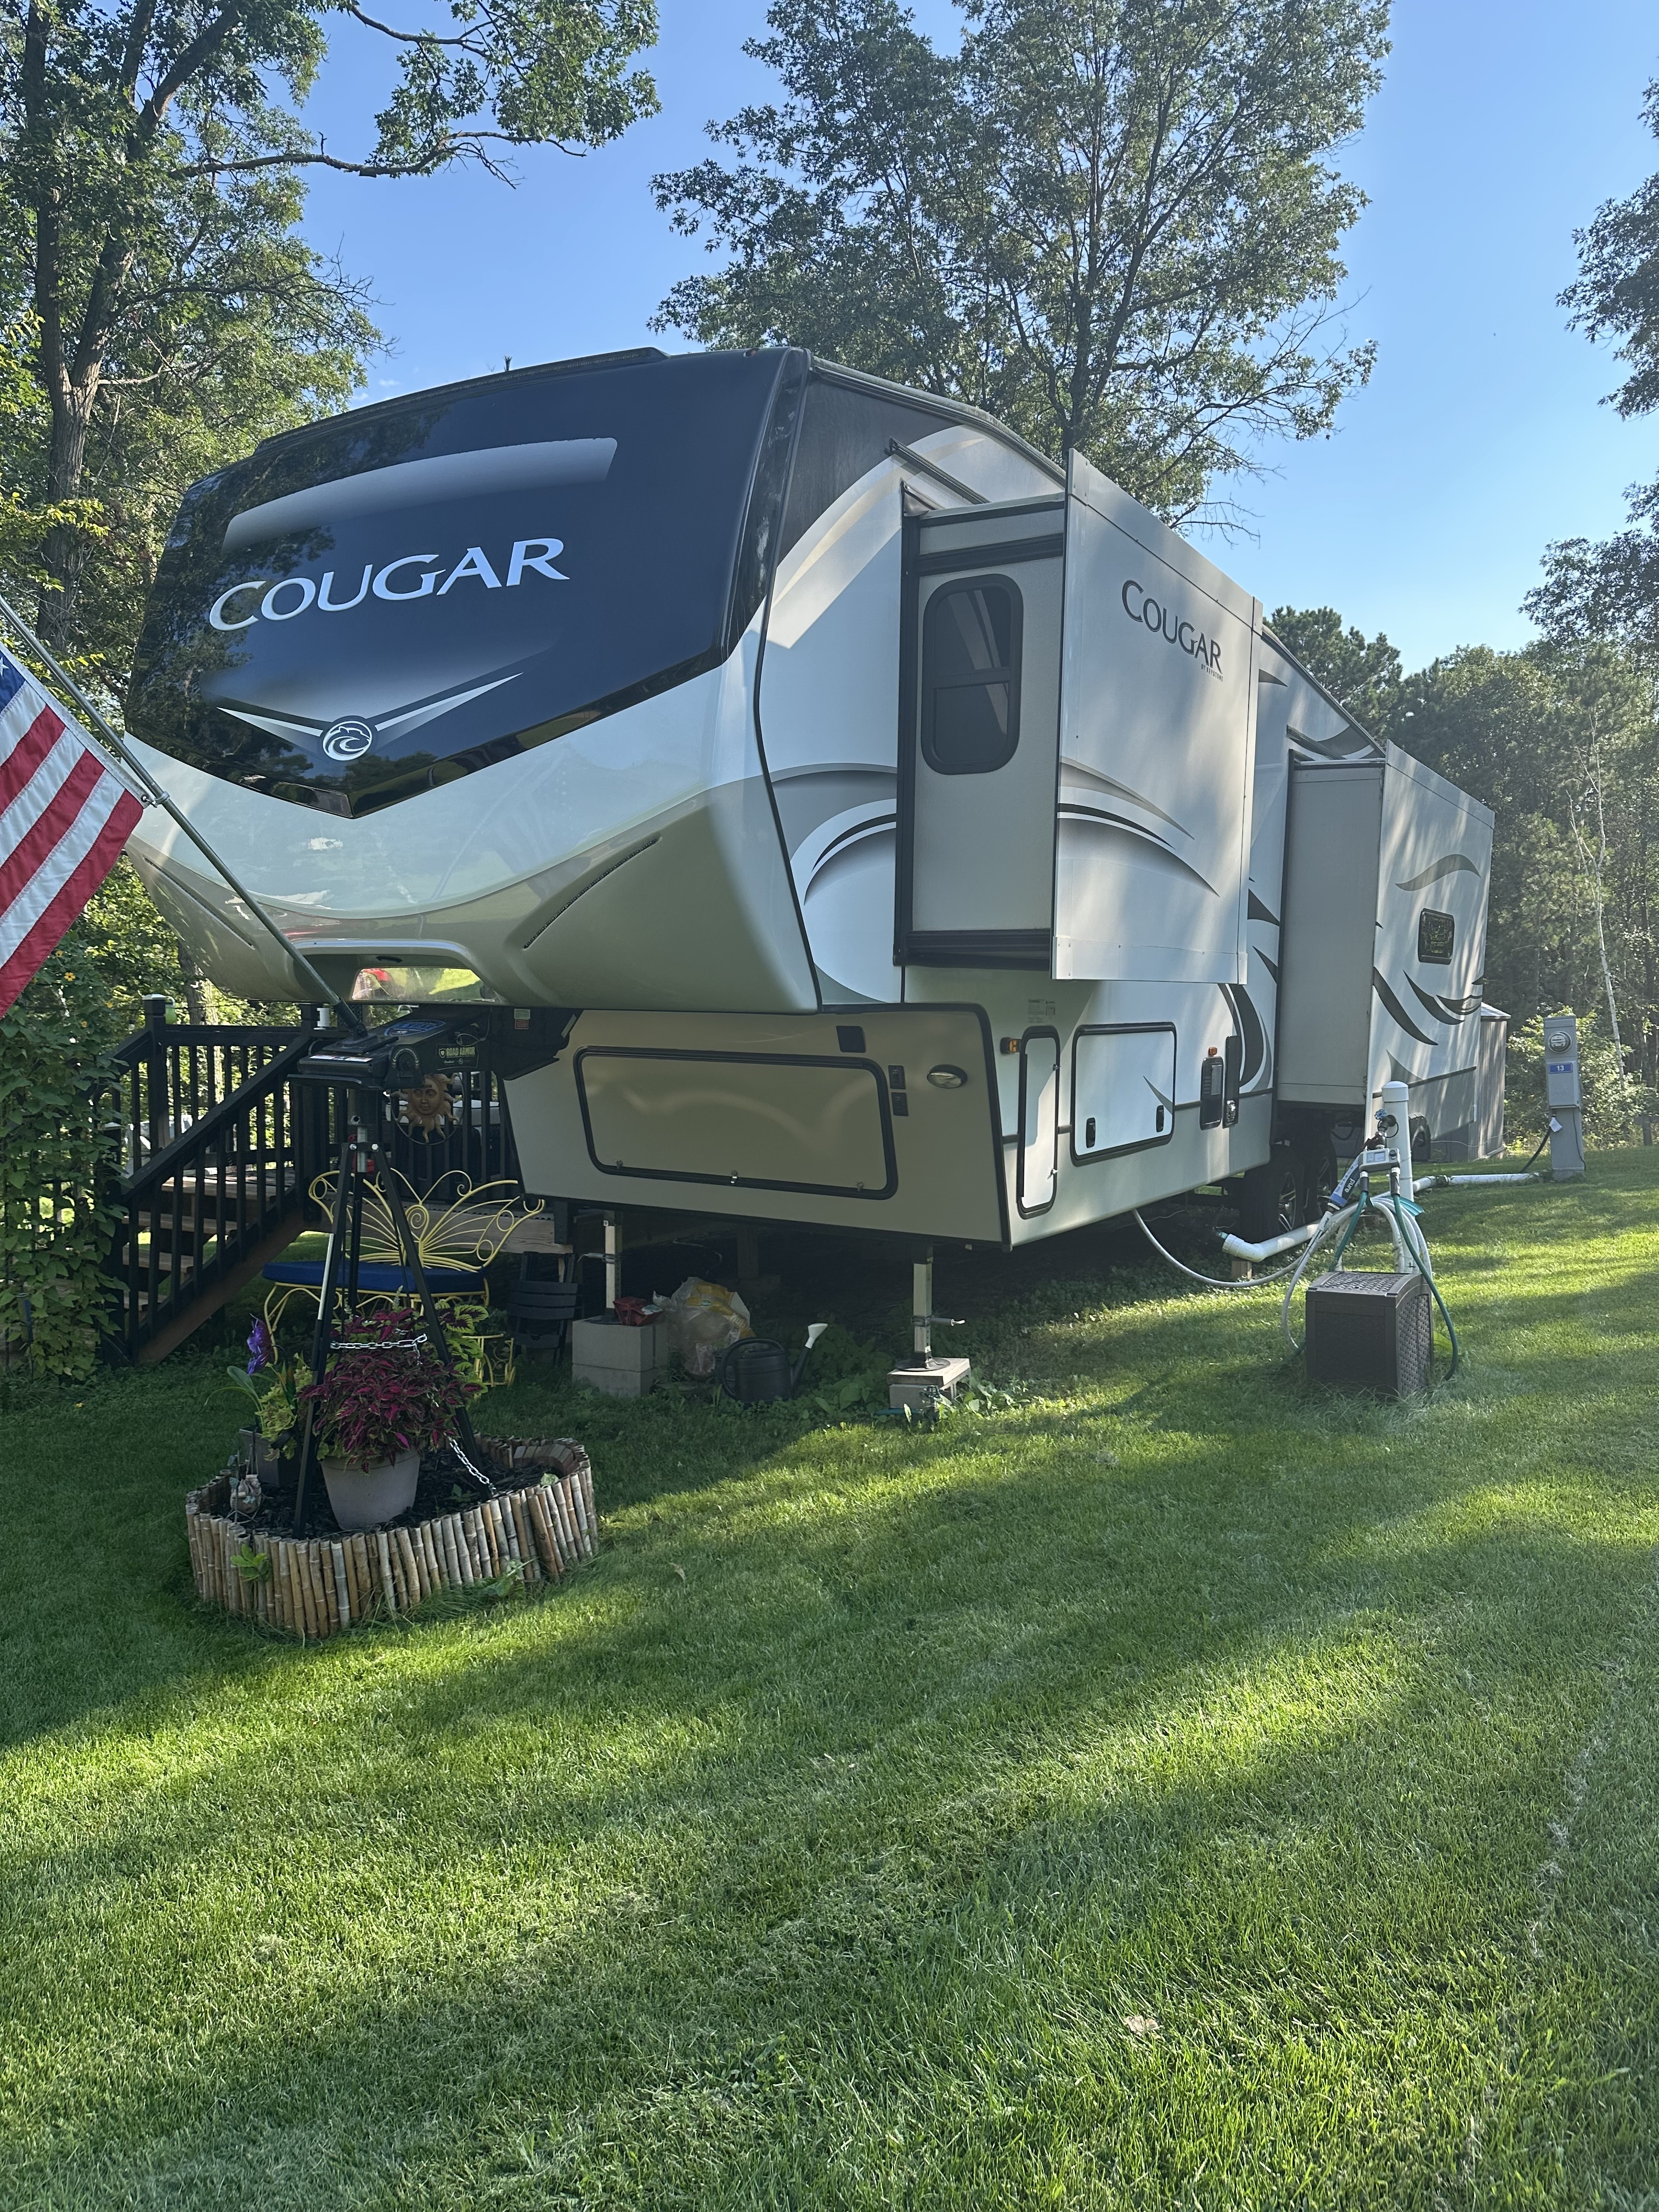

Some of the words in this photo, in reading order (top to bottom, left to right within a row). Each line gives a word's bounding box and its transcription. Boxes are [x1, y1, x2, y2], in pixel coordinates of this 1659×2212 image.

[209, 537, 570, 631] COUGAR
[1121, 579, 1223, 675] COUGAR
[1206, 667, 1223, 682] KEYSTONE
[446, 1047, 459, 1057] ROAD
[459, 1046, 476, 1056] ARMOR
